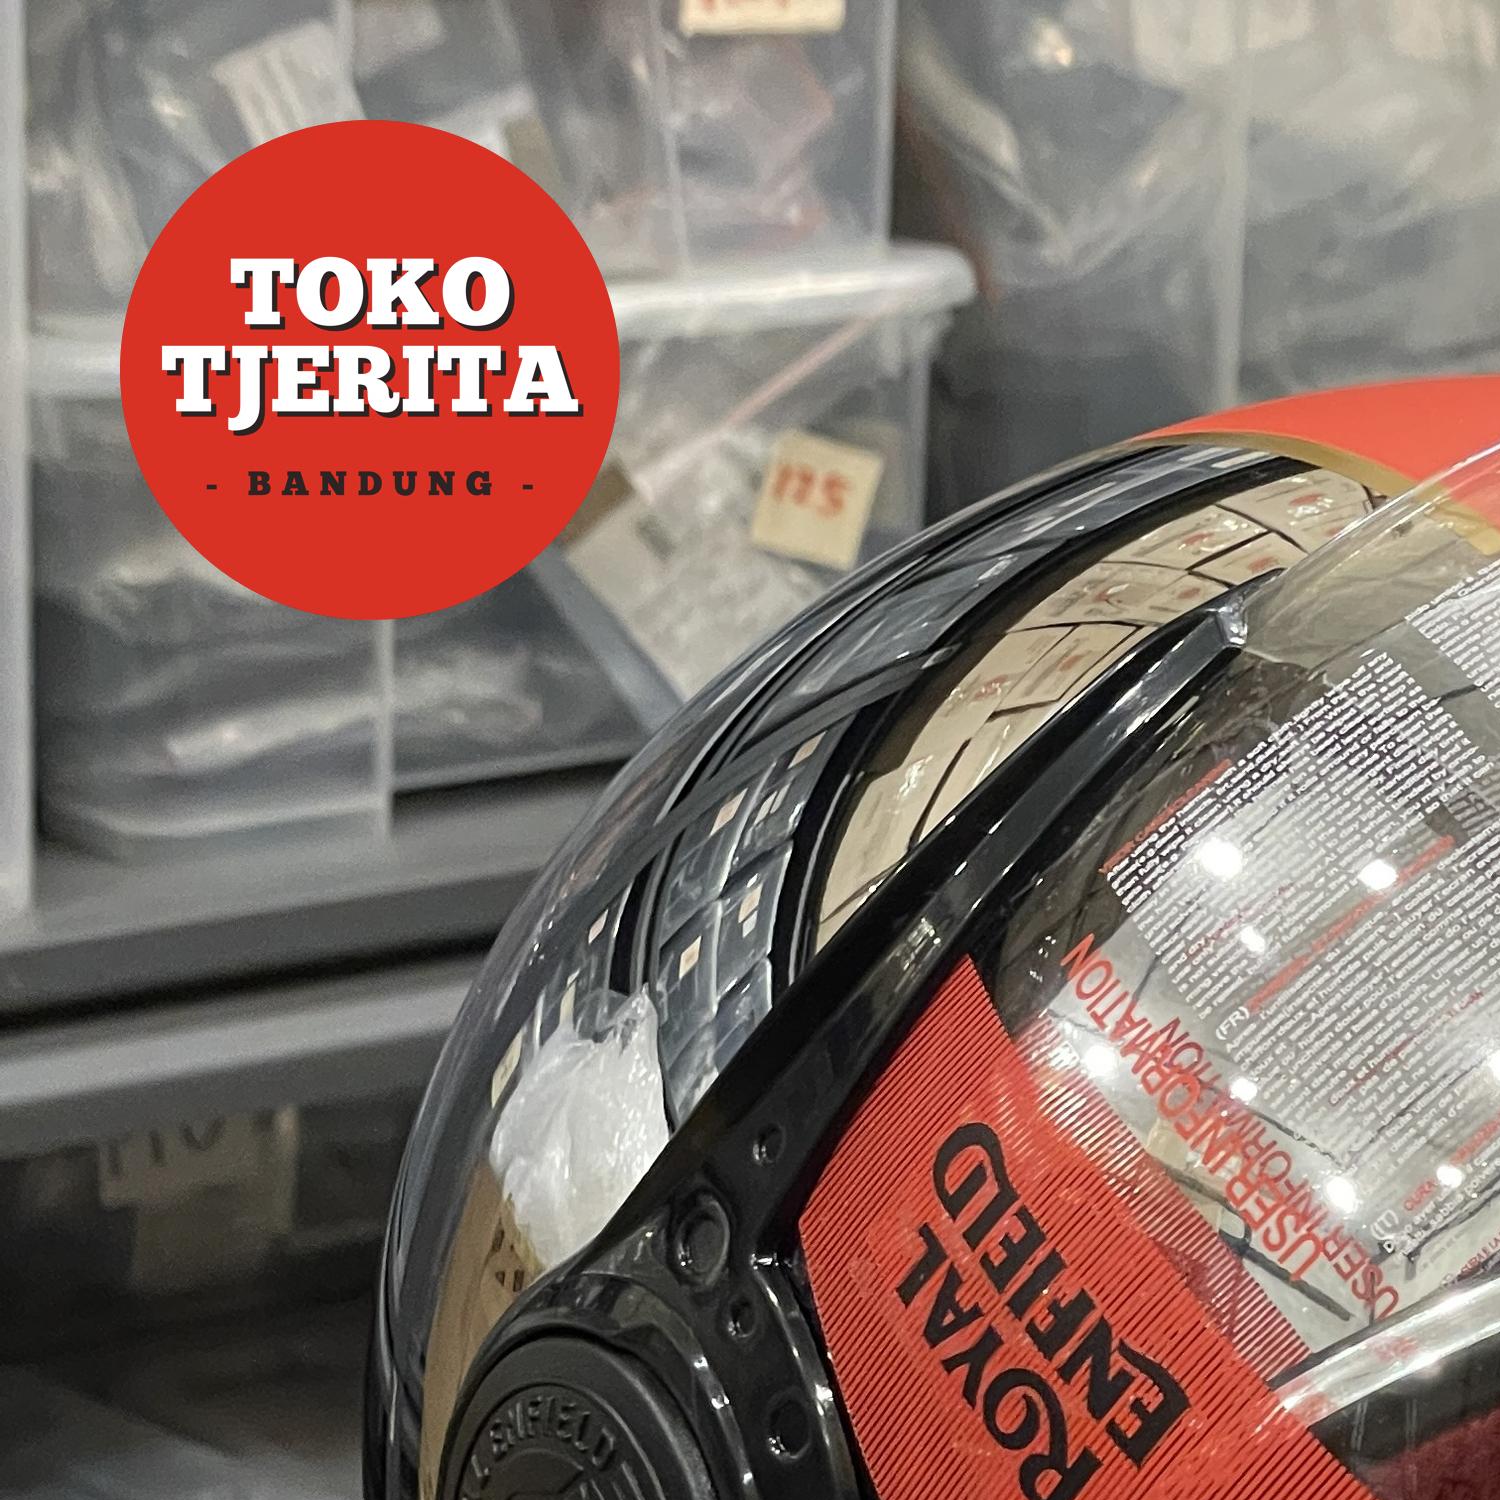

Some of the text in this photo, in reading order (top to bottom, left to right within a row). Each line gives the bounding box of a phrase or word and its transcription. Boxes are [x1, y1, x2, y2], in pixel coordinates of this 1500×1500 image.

[1060, 932, 1245, 1176] INFORMATION
[1212, 1004, 1252, 1040] (FR)
[932, 1121, 1191, 1470] ENFIELD
[1225, 1150, 1323, 1283] USER
